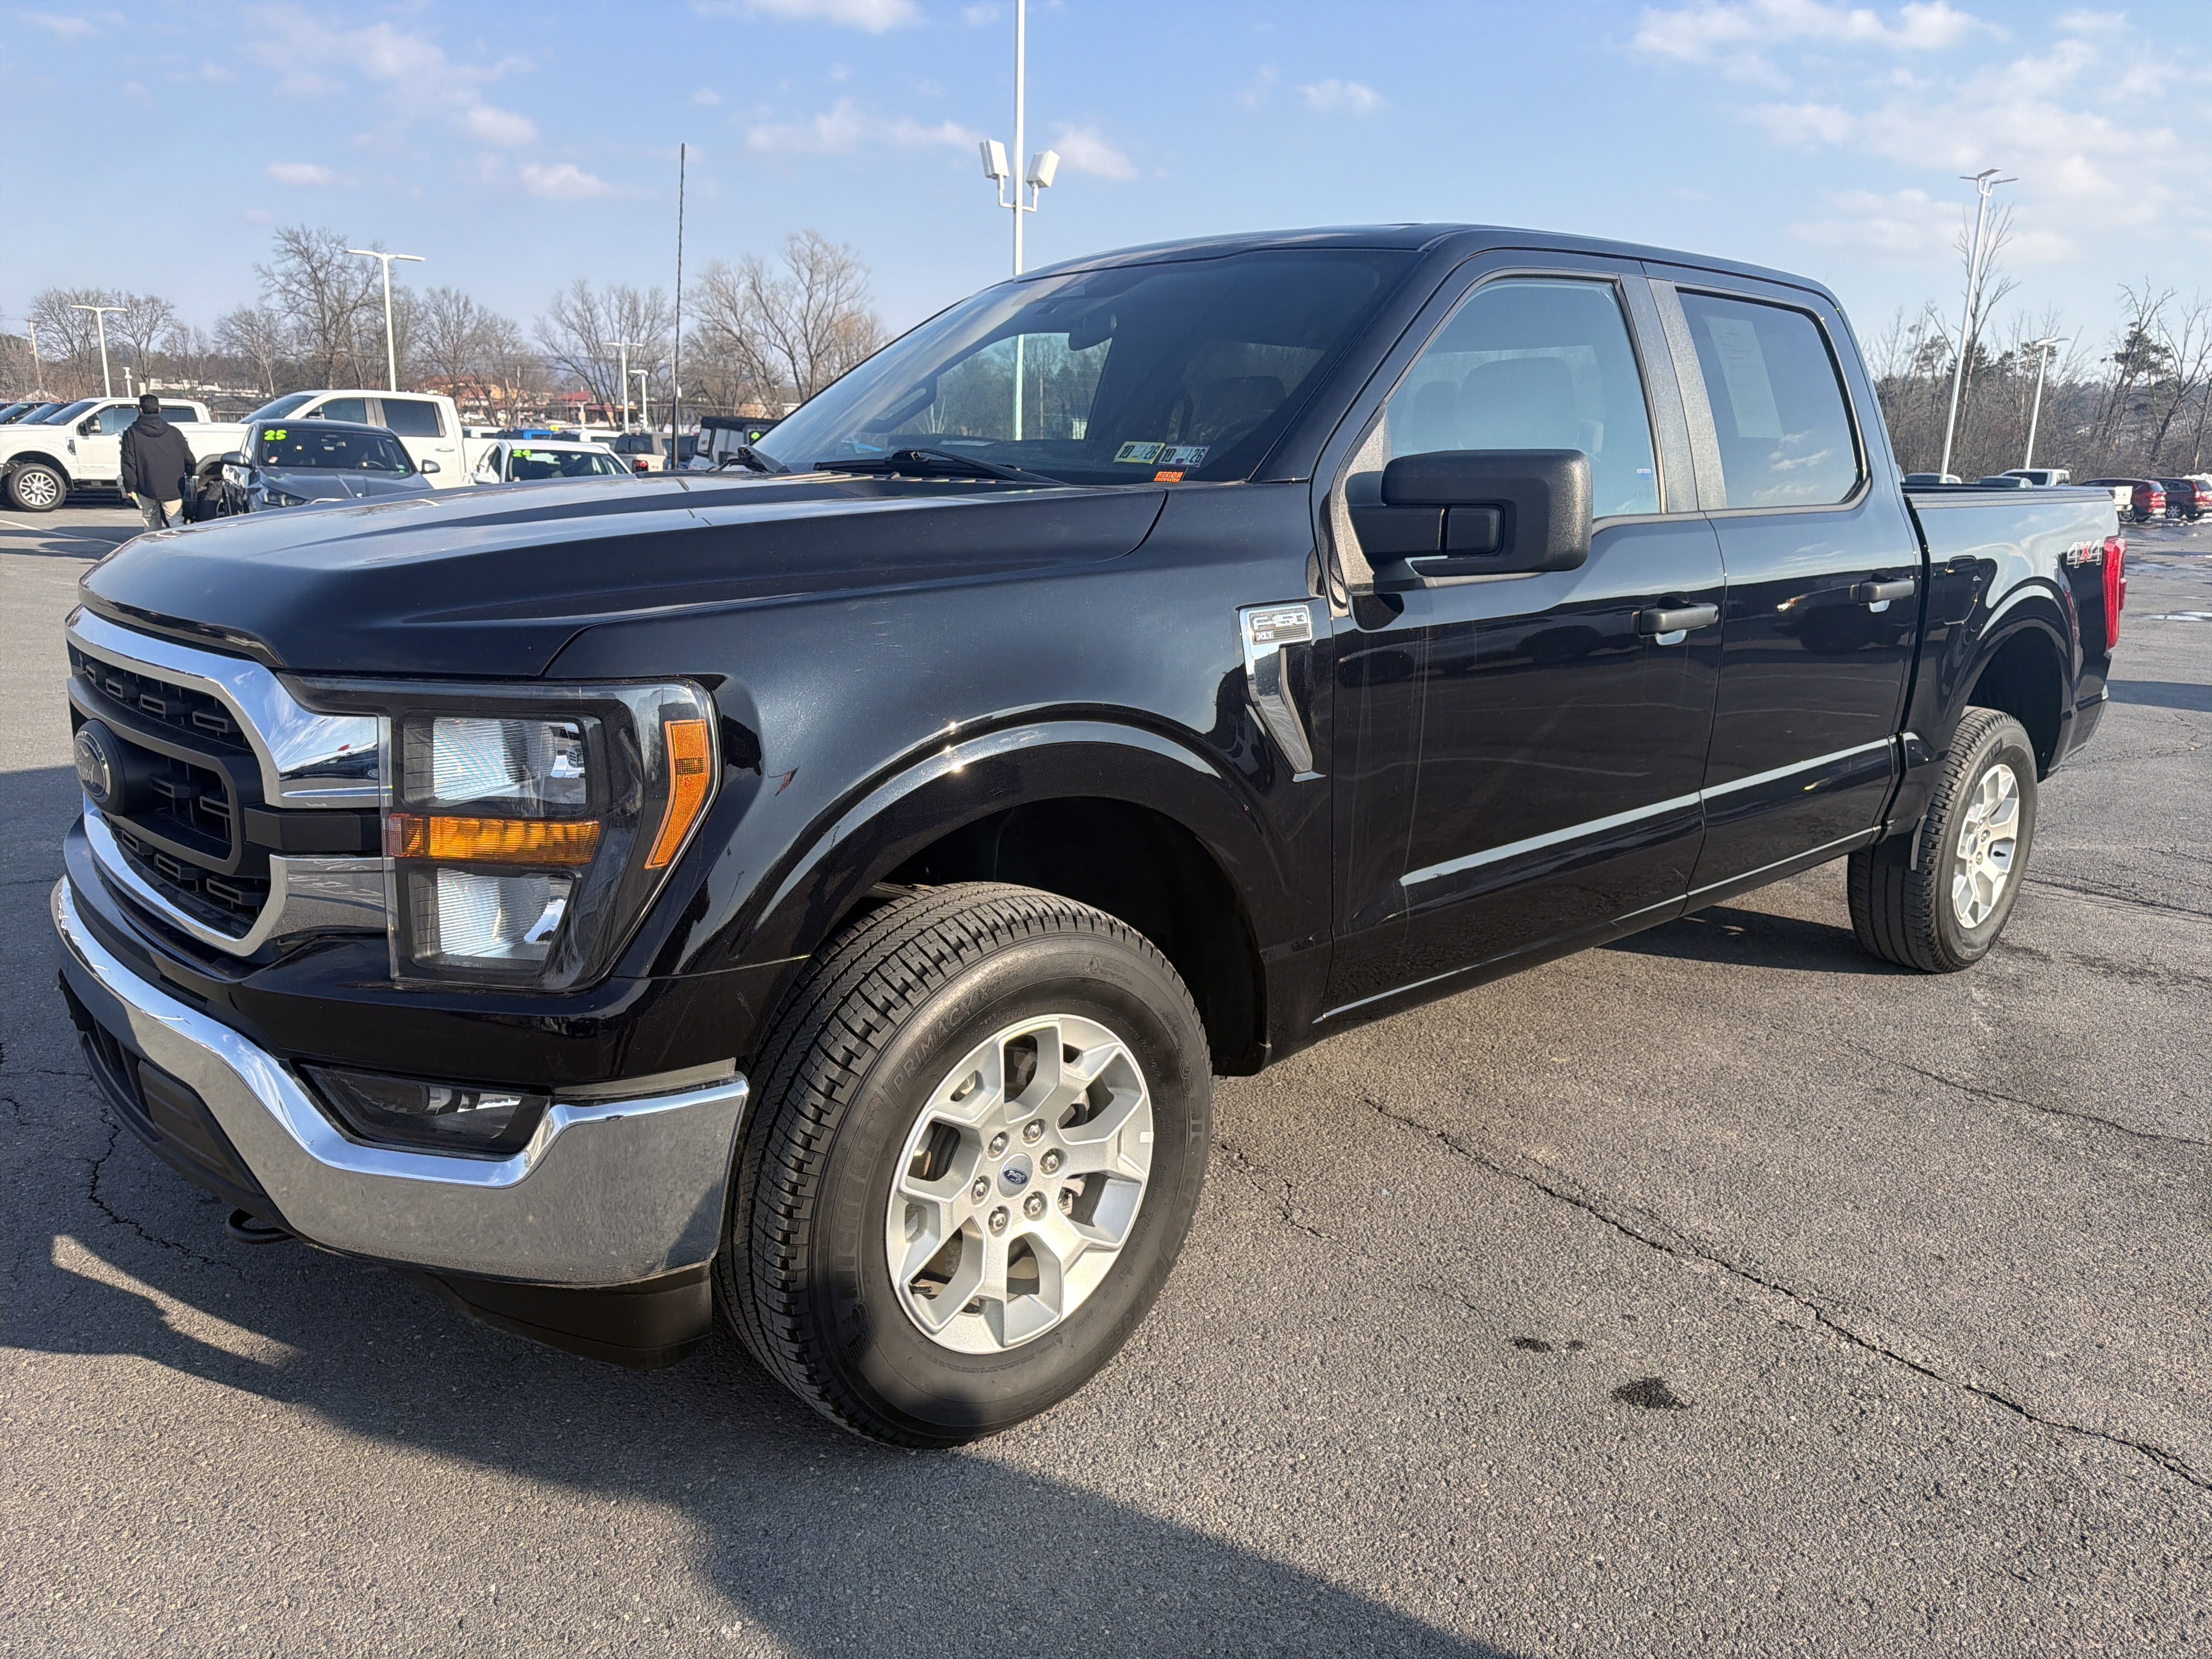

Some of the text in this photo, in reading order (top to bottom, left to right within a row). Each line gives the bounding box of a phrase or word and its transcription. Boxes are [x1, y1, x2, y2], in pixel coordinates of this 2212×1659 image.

[264, 430, 287, 441] 25
[512, 449, 532, 458] 24
[1119, 445, 1159, 460] 10 26
[1161, 448, 1205, 463] 10 26
[1252, 612, 1308, 630] F-150
[1256, 631, 1274, 640] XLT
[76, 745, 95, 785] Ford
[893, 986, 979, 1093] PRIMACY
[1007, 1170, 1025, 1183] Ford
